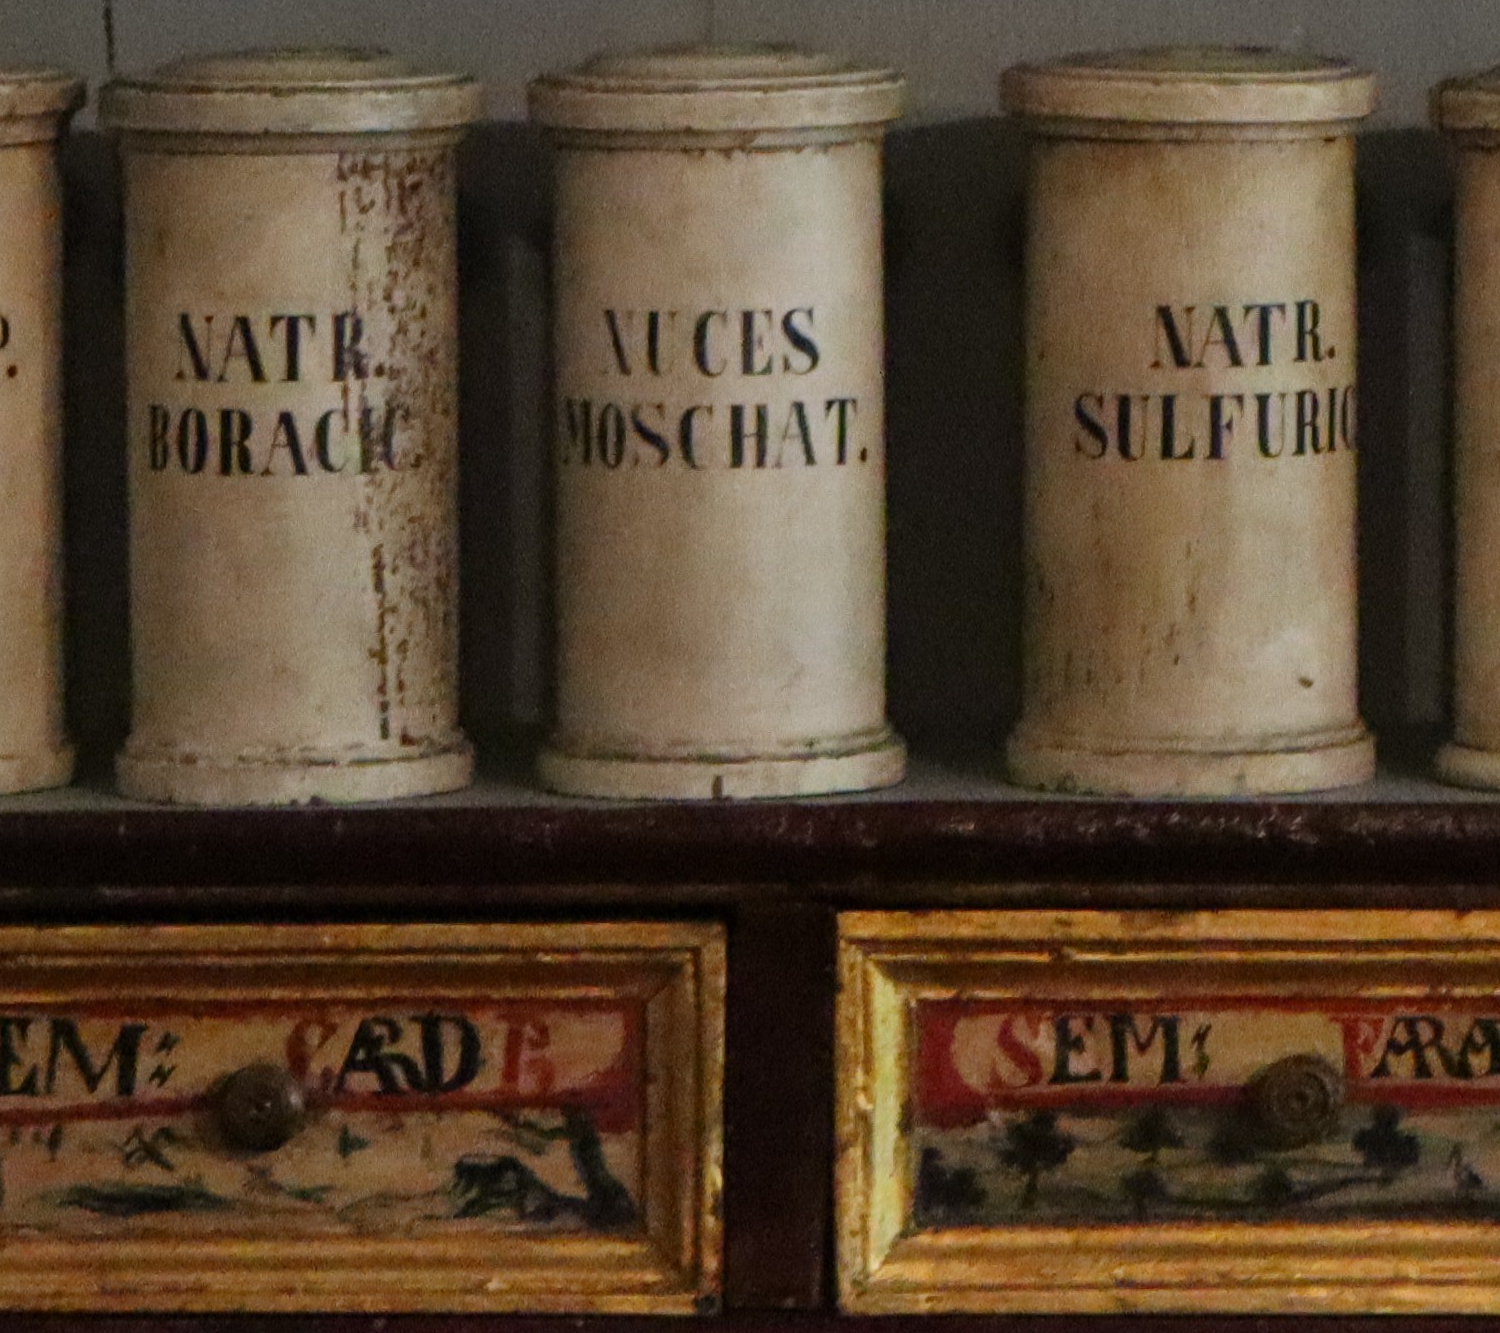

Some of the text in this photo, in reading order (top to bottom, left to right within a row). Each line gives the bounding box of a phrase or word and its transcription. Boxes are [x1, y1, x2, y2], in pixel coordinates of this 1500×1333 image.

[178, 312, 386, 383] NATR.
[602, 307, 820, 377] NUCES
[1150, 300, 1335, 369] NATR.
